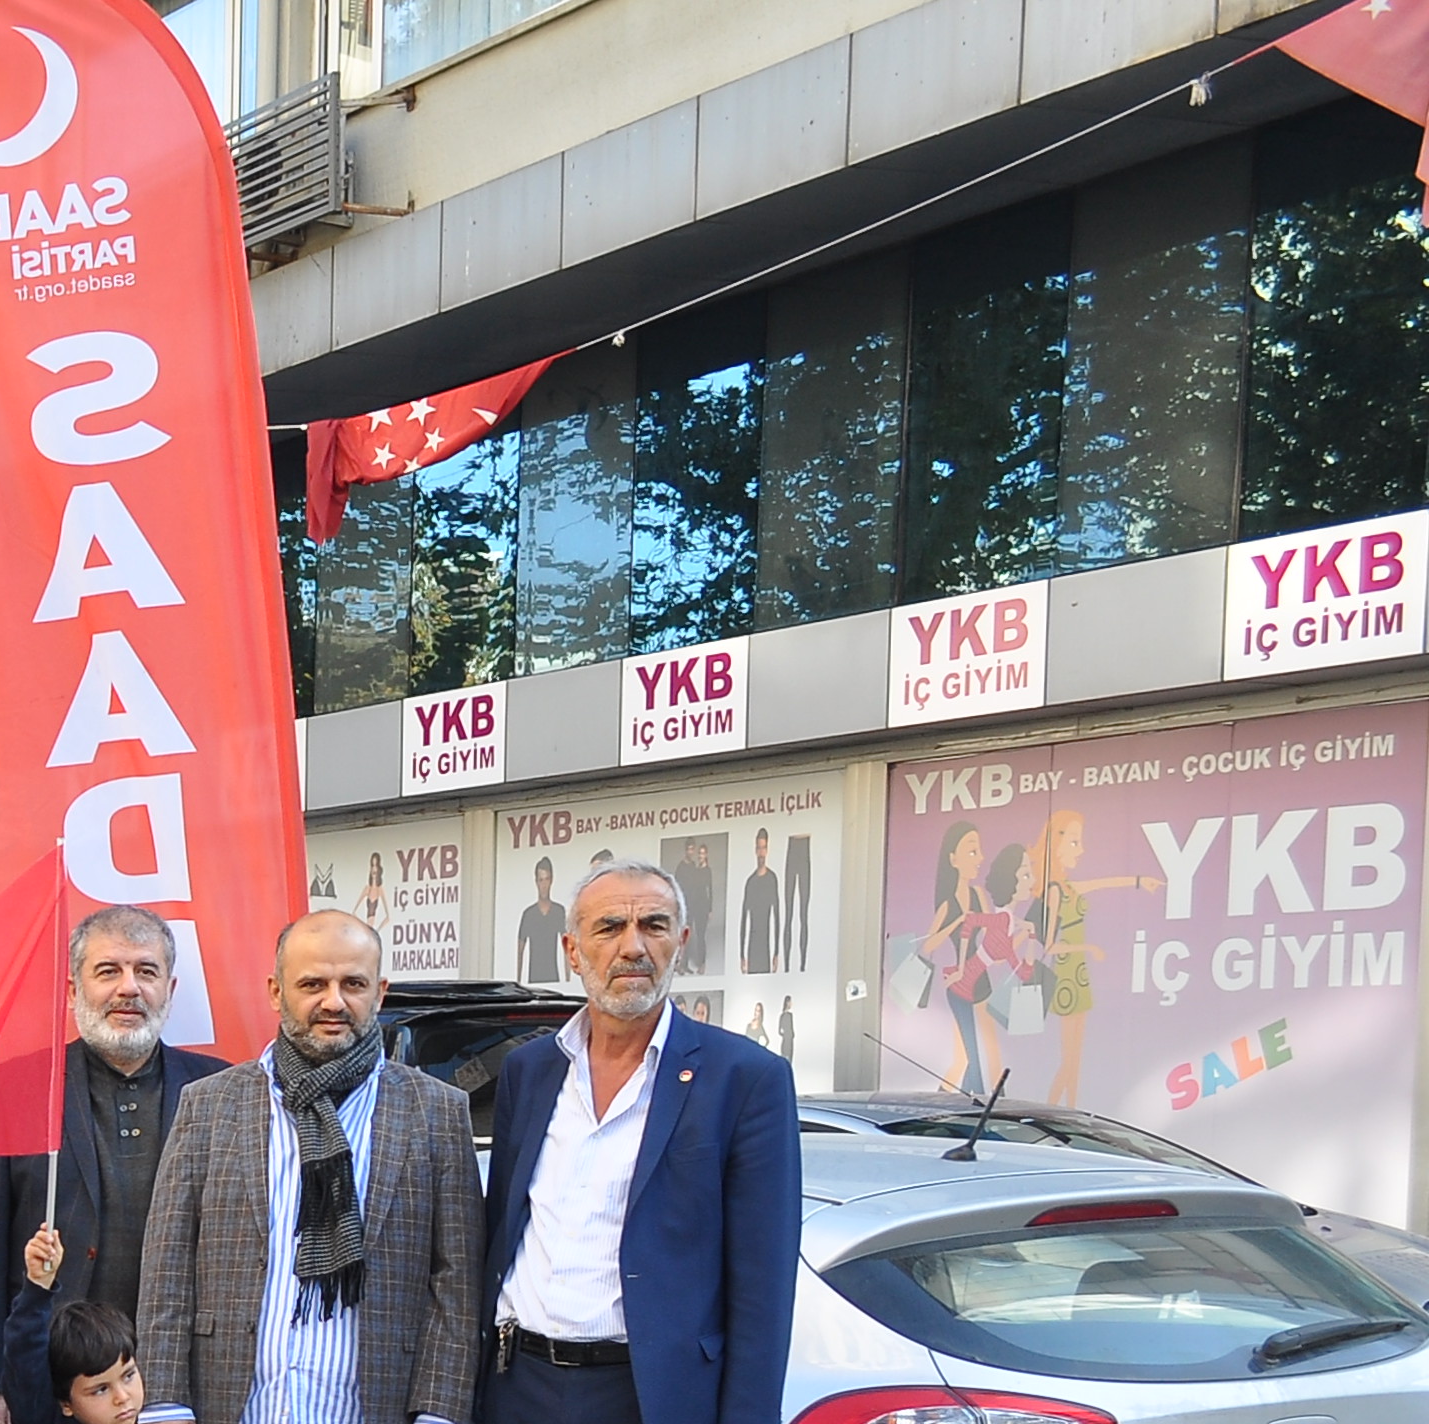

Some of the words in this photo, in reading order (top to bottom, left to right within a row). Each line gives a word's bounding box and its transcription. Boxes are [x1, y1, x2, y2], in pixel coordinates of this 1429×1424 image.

[1252, 531, 1404, 610] YKB
[908, 599, 1029, 664] YKB
[1244, 619, 1279, 661] İÇ
[1293, 602, 1404, 648] GİYİM
[637, 653, 733, 709] YKB
[904, 675, 931, 711] İÇ
[942, 659, 1029, 700] GİYİM
[415, 695, 495, 746] YKB
[632, 718, 655, 751] İÇ
[664, 706, 734, 741] GİYİM
[412, 756, 431, 784] İÇ
[438, 743, 496, 774] GİYİM
[905, 764, 1014, 815] YKB
[1019, 771, 1063, 795] BAY
[1083, 760, 1160, 787] BAYAN
[1182, 747, 1272, 782] ÇOCUK
[1279, 739, 1306, 770] İÇ
[1314, 732, 1395, 764] GİYİM
[507, 811, 572, 849] YKB
[575, 816, 602, 837] BAY
[659, 807, 711, 831] ÇOCUK
[715, 800, 775, 821] TERMAL
[780, 790, 823, 816] İÇLİK
[397, 844, 460, 882] YKB
[1142, 802, 1407, 919] YKB
[393, 887, 409, 912] İÇ
[412, 884, 460, 908] GİYİM
[393, 918, 457, 945] DÜNYA
[392, 948, 460, 972] MARKALARI
[1131, 930, 1190, 1006] İÇ
[1212, 921, 1406, 993] GİYİM
[1165, 1018, 1293, 1111] SALE
